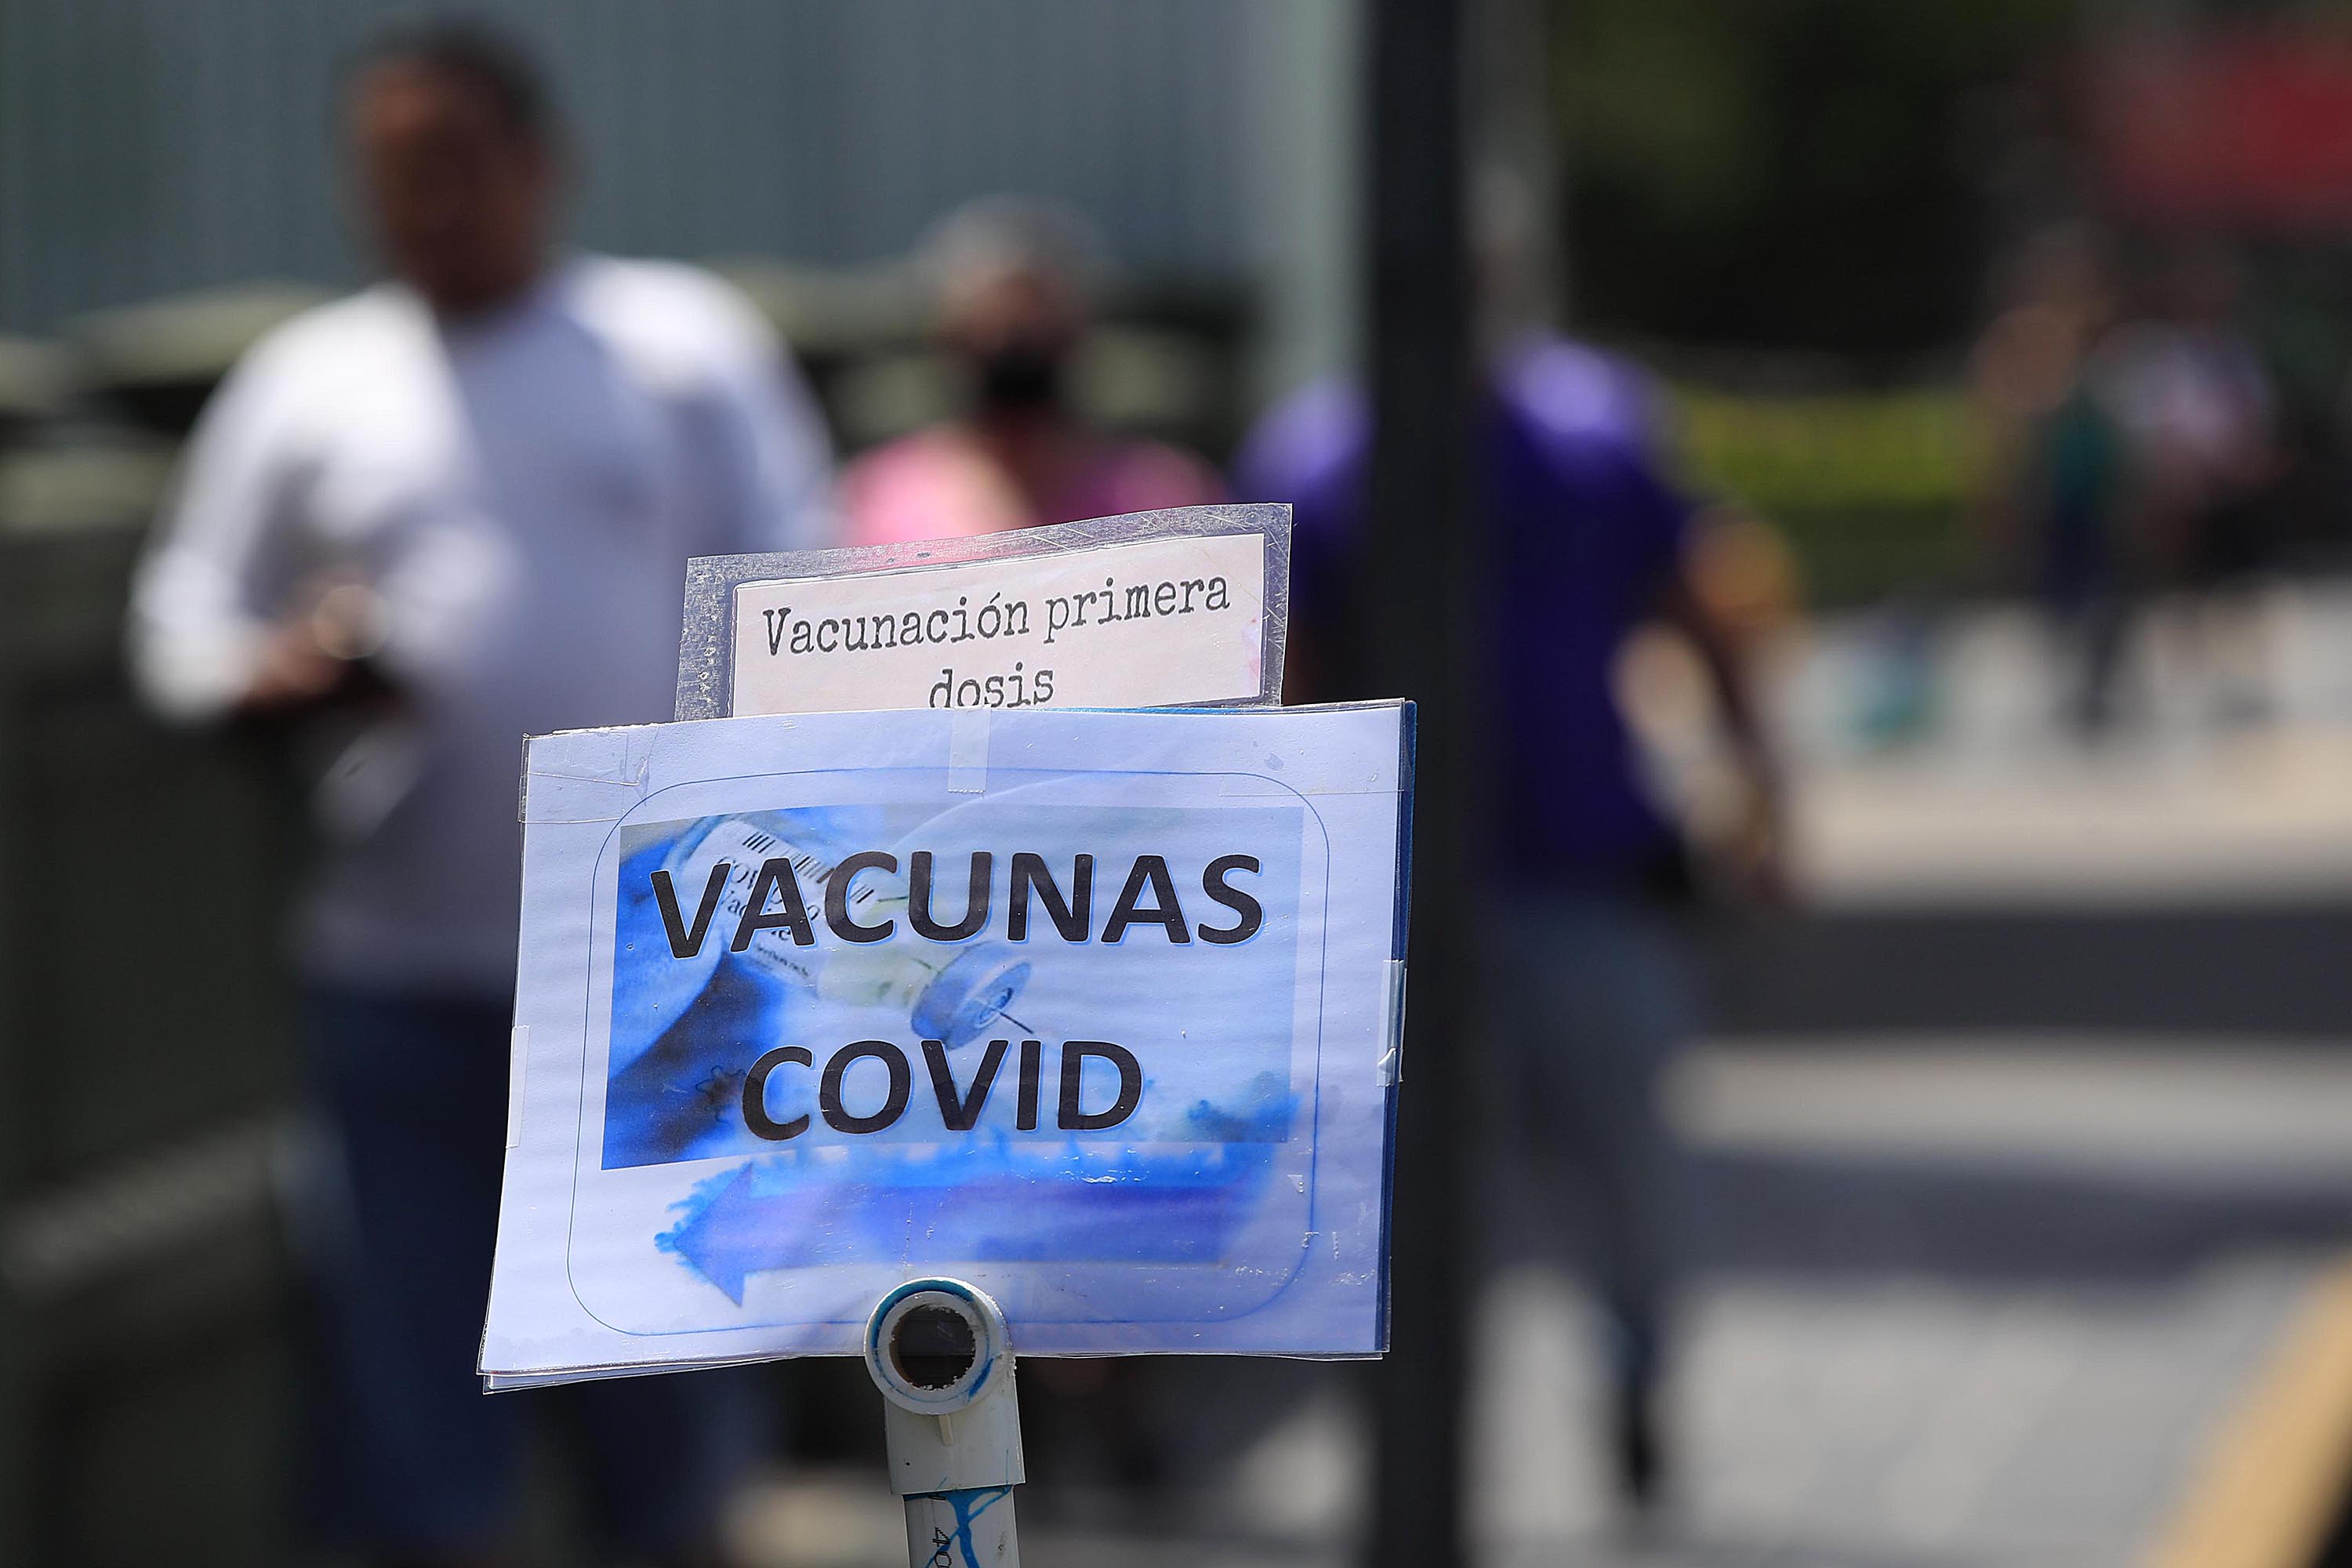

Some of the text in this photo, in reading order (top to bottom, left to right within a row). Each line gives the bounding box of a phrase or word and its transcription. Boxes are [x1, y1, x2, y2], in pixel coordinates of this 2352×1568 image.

[762, 575, 1231, 657] Vacunación primera
[929, 661, 1054, 708] dosis
[650, 850, 1263, 959] VACUNAS
[741, 1040, 1143, 1141] COVID
